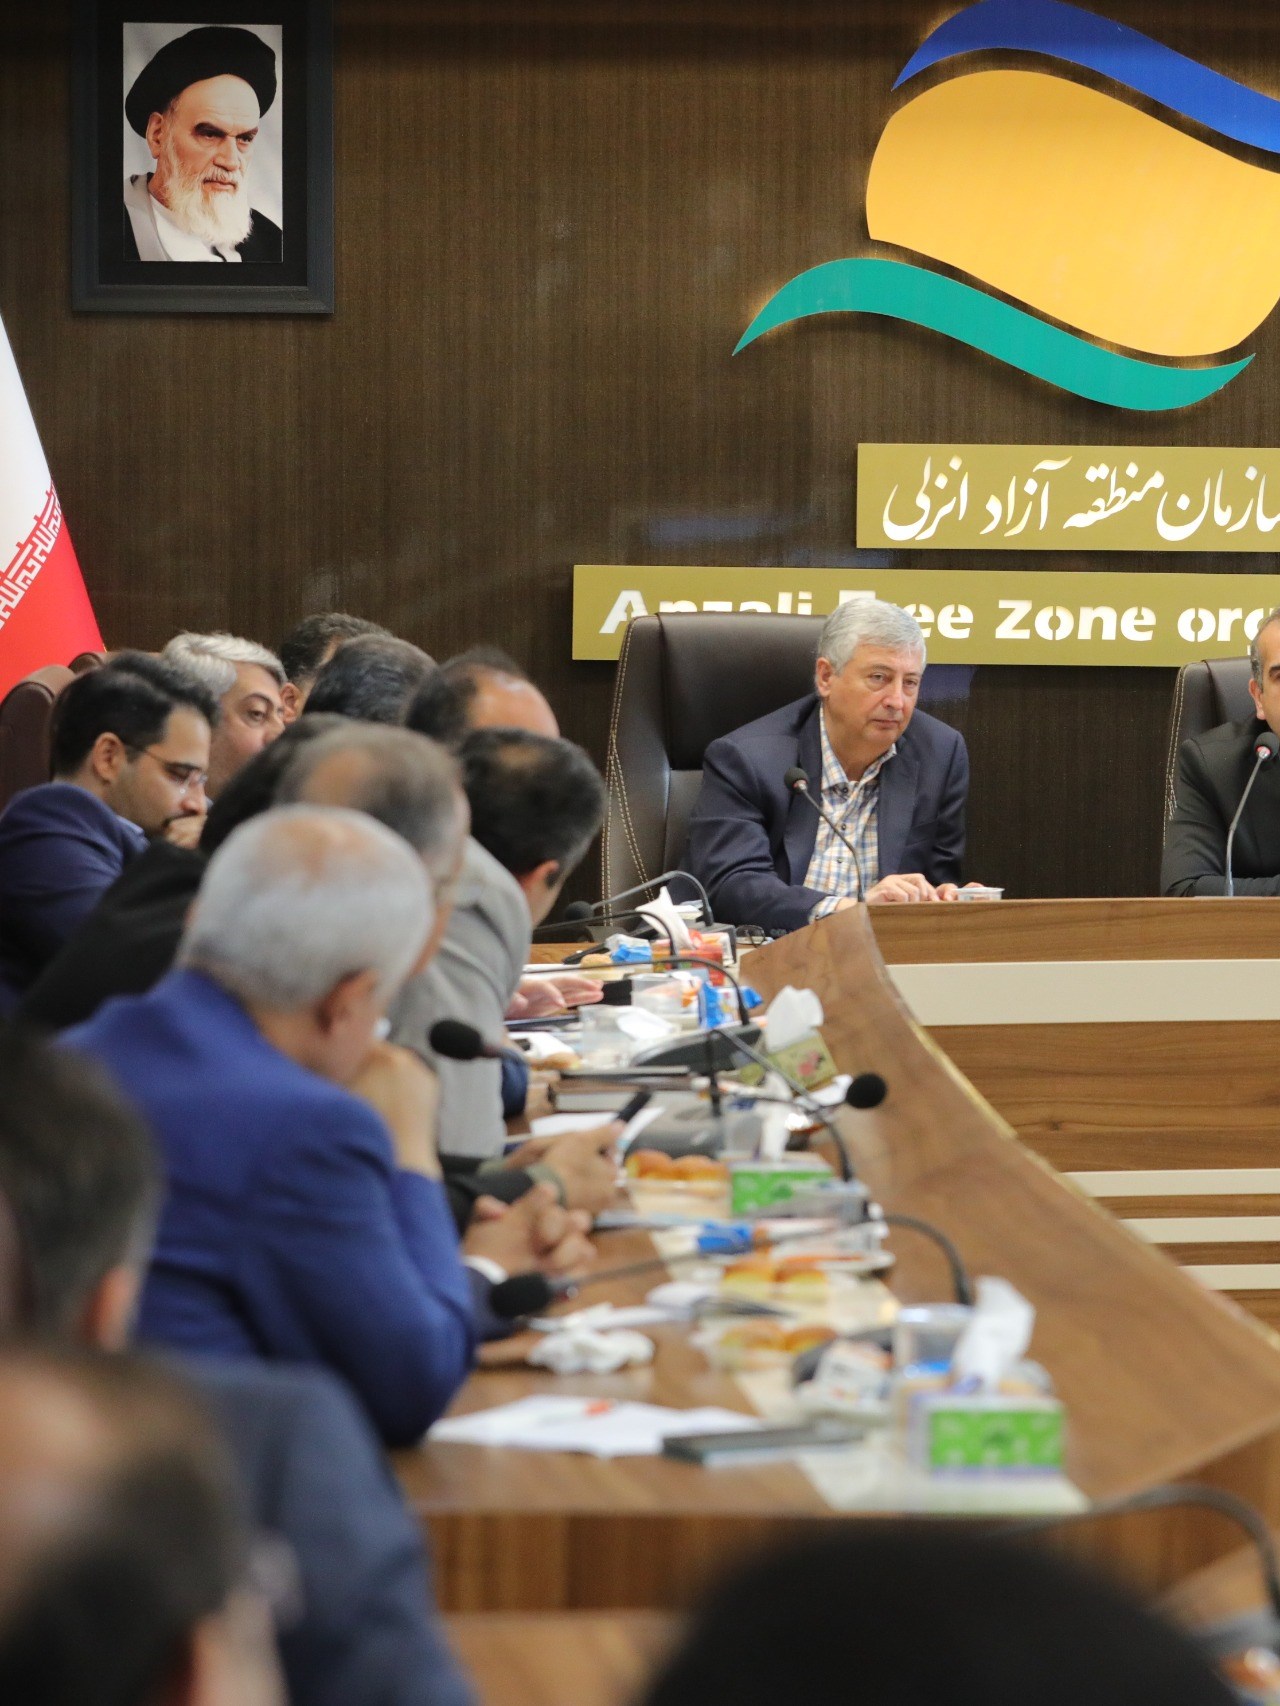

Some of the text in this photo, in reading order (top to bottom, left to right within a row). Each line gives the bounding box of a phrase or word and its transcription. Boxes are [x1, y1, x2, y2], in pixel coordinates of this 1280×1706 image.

[882, 455, 969, 541] انزلی
[980, 455, 1073, 537] آزاد
[1062, 461, 1165, 530] منطقه
[837, 589, 974, 640] ee
